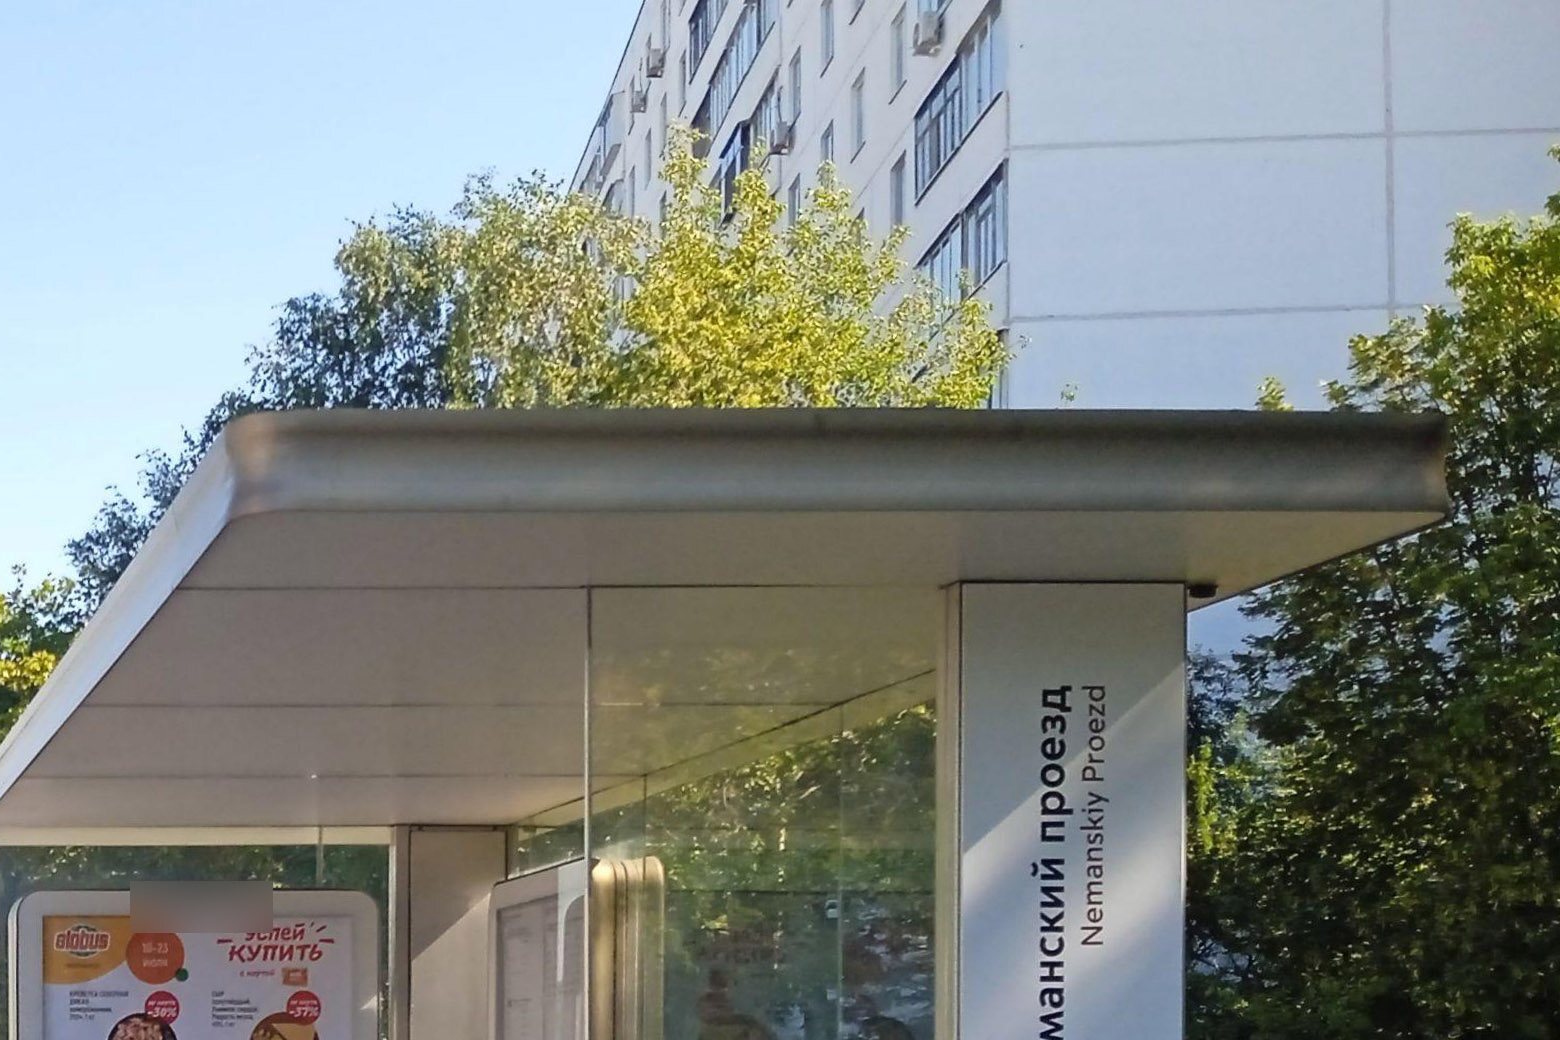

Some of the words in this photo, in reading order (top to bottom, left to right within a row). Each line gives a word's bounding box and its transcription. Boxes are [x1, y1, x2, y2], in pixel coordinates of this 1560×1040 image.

[1040, 684, 1073, 852] проезд
[1081, 684, 1106, 782] Proezd
[1081, 791, 1110, 946] Nemanskiy
[229, 944, 323, 962] КУПИТЬ
